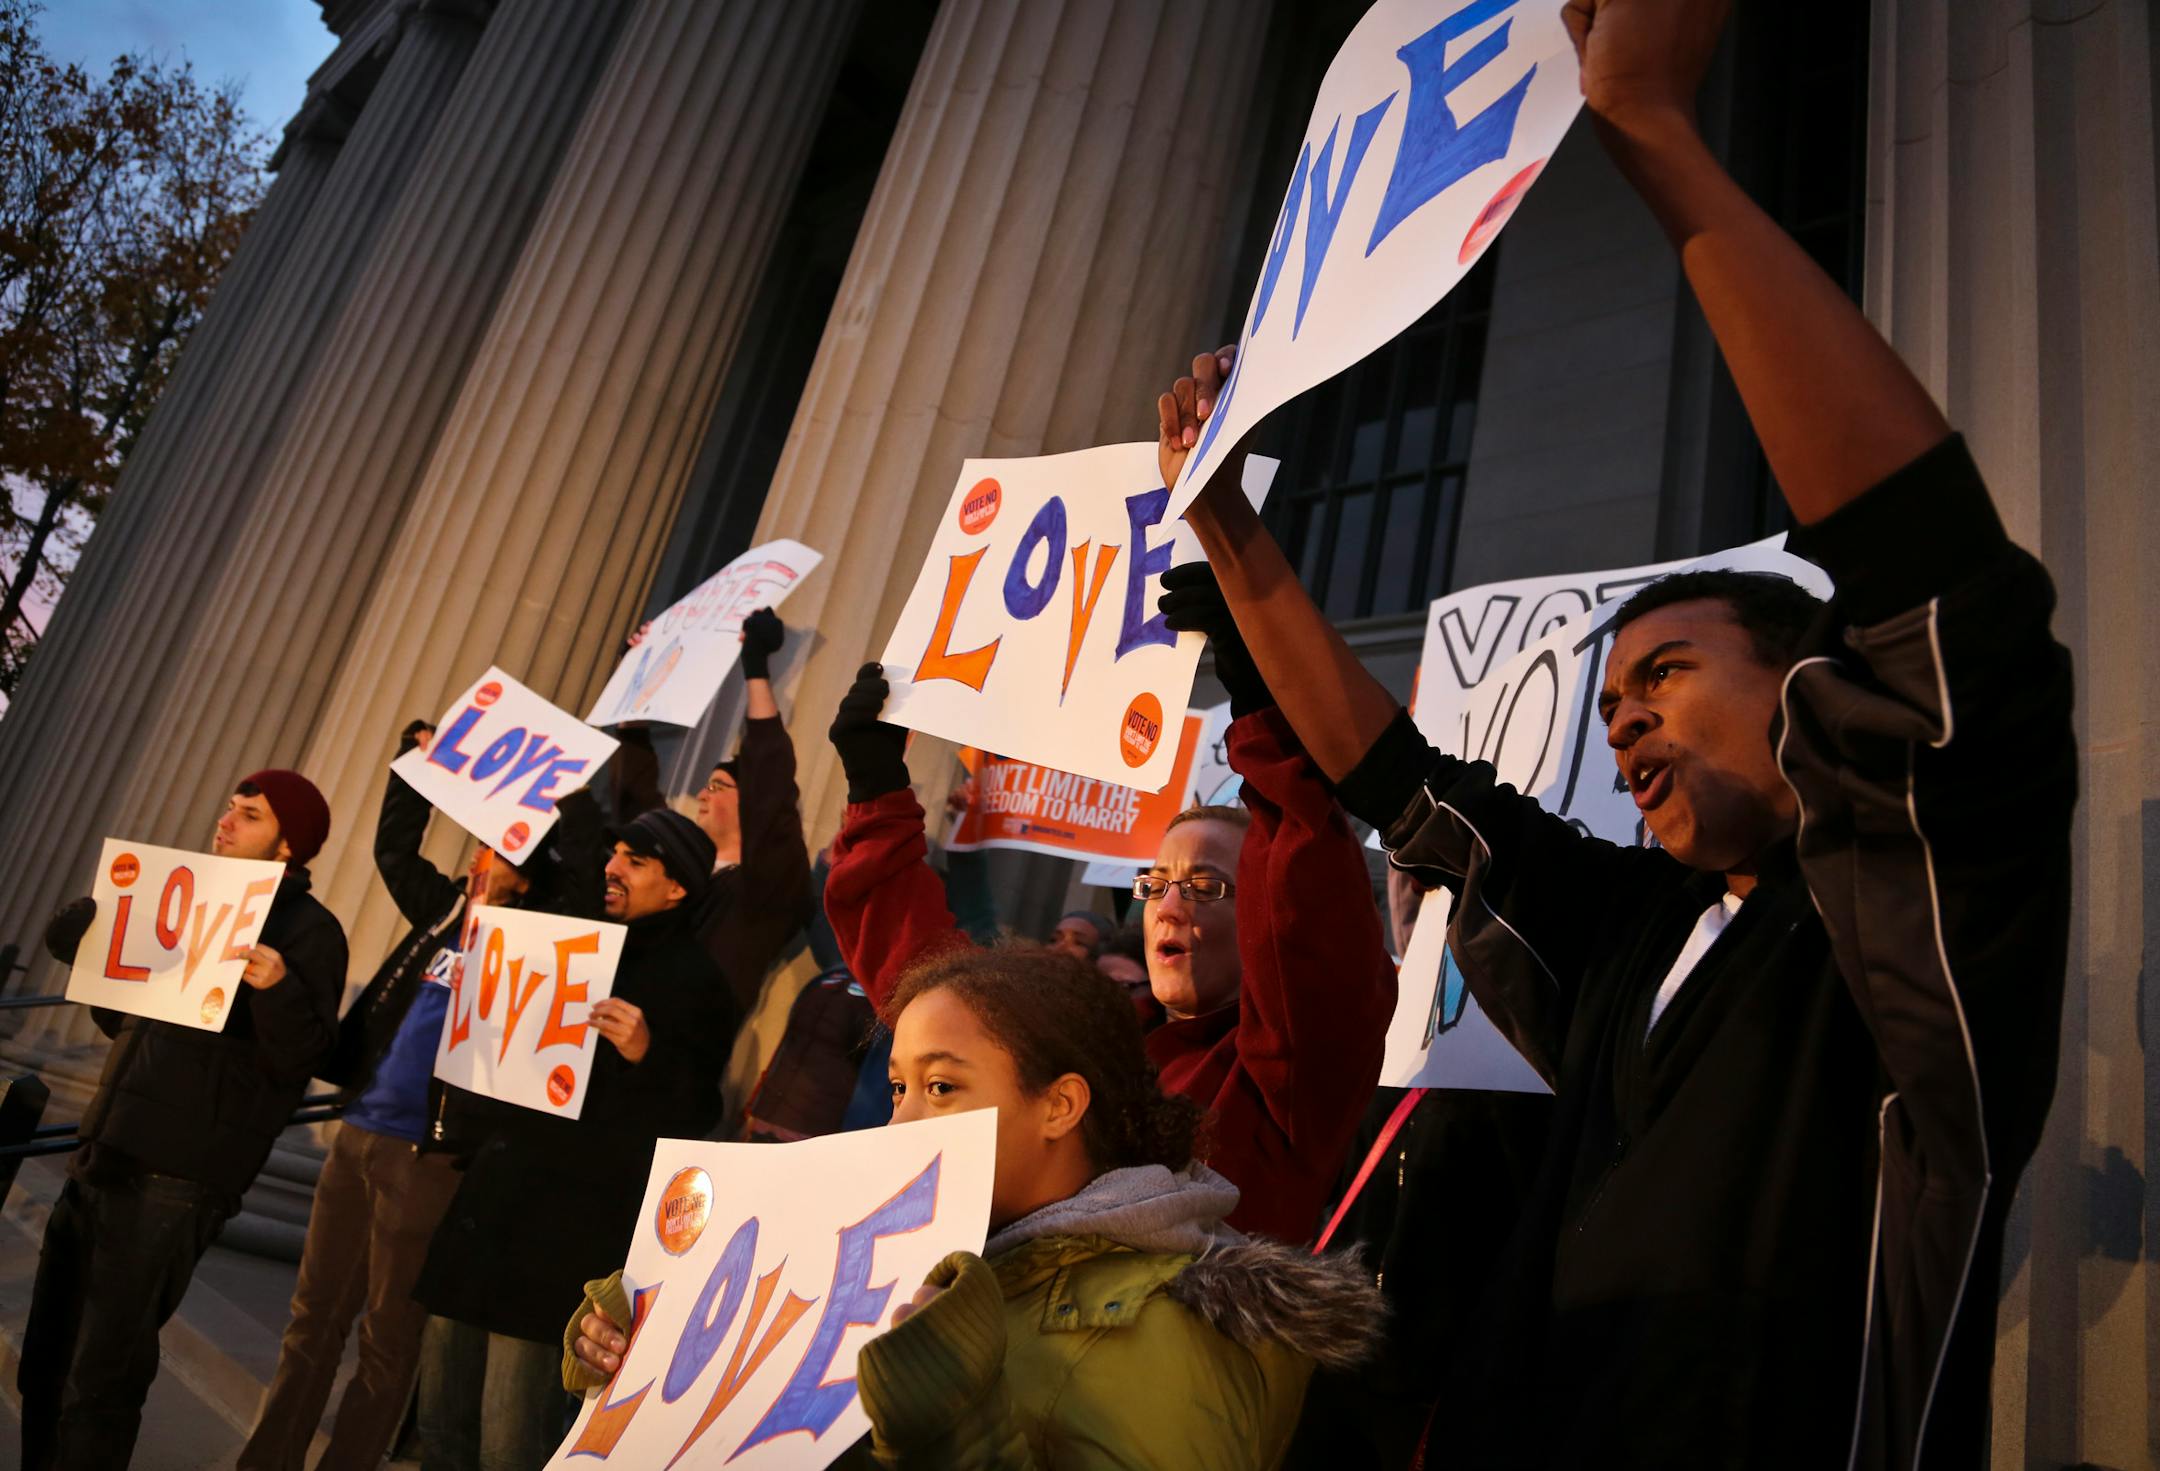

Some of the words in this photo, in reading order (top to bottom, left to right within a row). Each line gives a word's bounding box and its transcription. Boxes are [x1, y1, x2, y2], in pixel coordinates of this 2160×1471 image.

[911, 487, 1185, 707] LOVE
[426, 706, 590, 814] LOVE
[1127, 708, 1148, 736] VOTE
[1144, 720, 1158, 741] NO
[982, 763, 1027, 792] ON'T
[1025, 767, 1097, 806] LIMIT
[1098, 780, 1141, 814] THE
[1041, 795, 1067, 820] TO
[1066, 803, 1139, 834] MARRY
[104, 866, 276, 994] LOVE
[448, 927, 600, 1067] LOVE
[565, 1149, 942, 1471] LOVE
